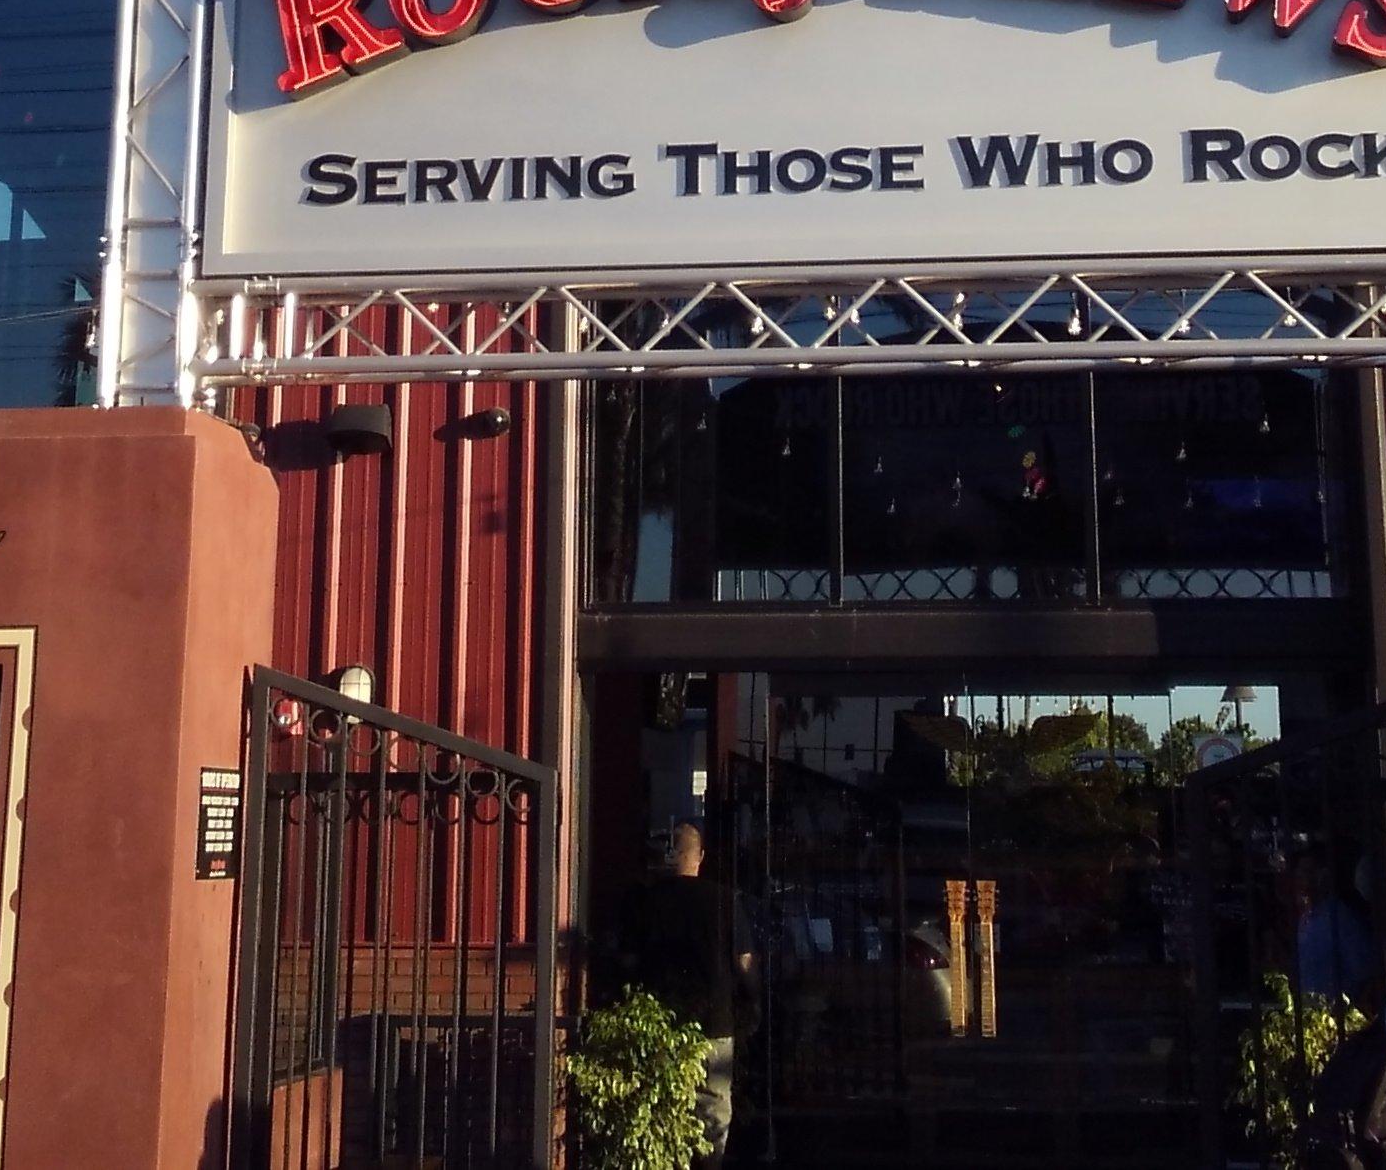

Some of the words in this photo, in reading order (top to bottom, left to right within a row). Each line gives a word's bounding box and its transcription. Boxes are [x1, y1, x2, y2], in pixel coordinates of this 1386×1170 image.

[306, 154, 636, 205] SERVING
[662, 143, 925, 194] THOSE
[956, 133, 1153, 189] WHO
